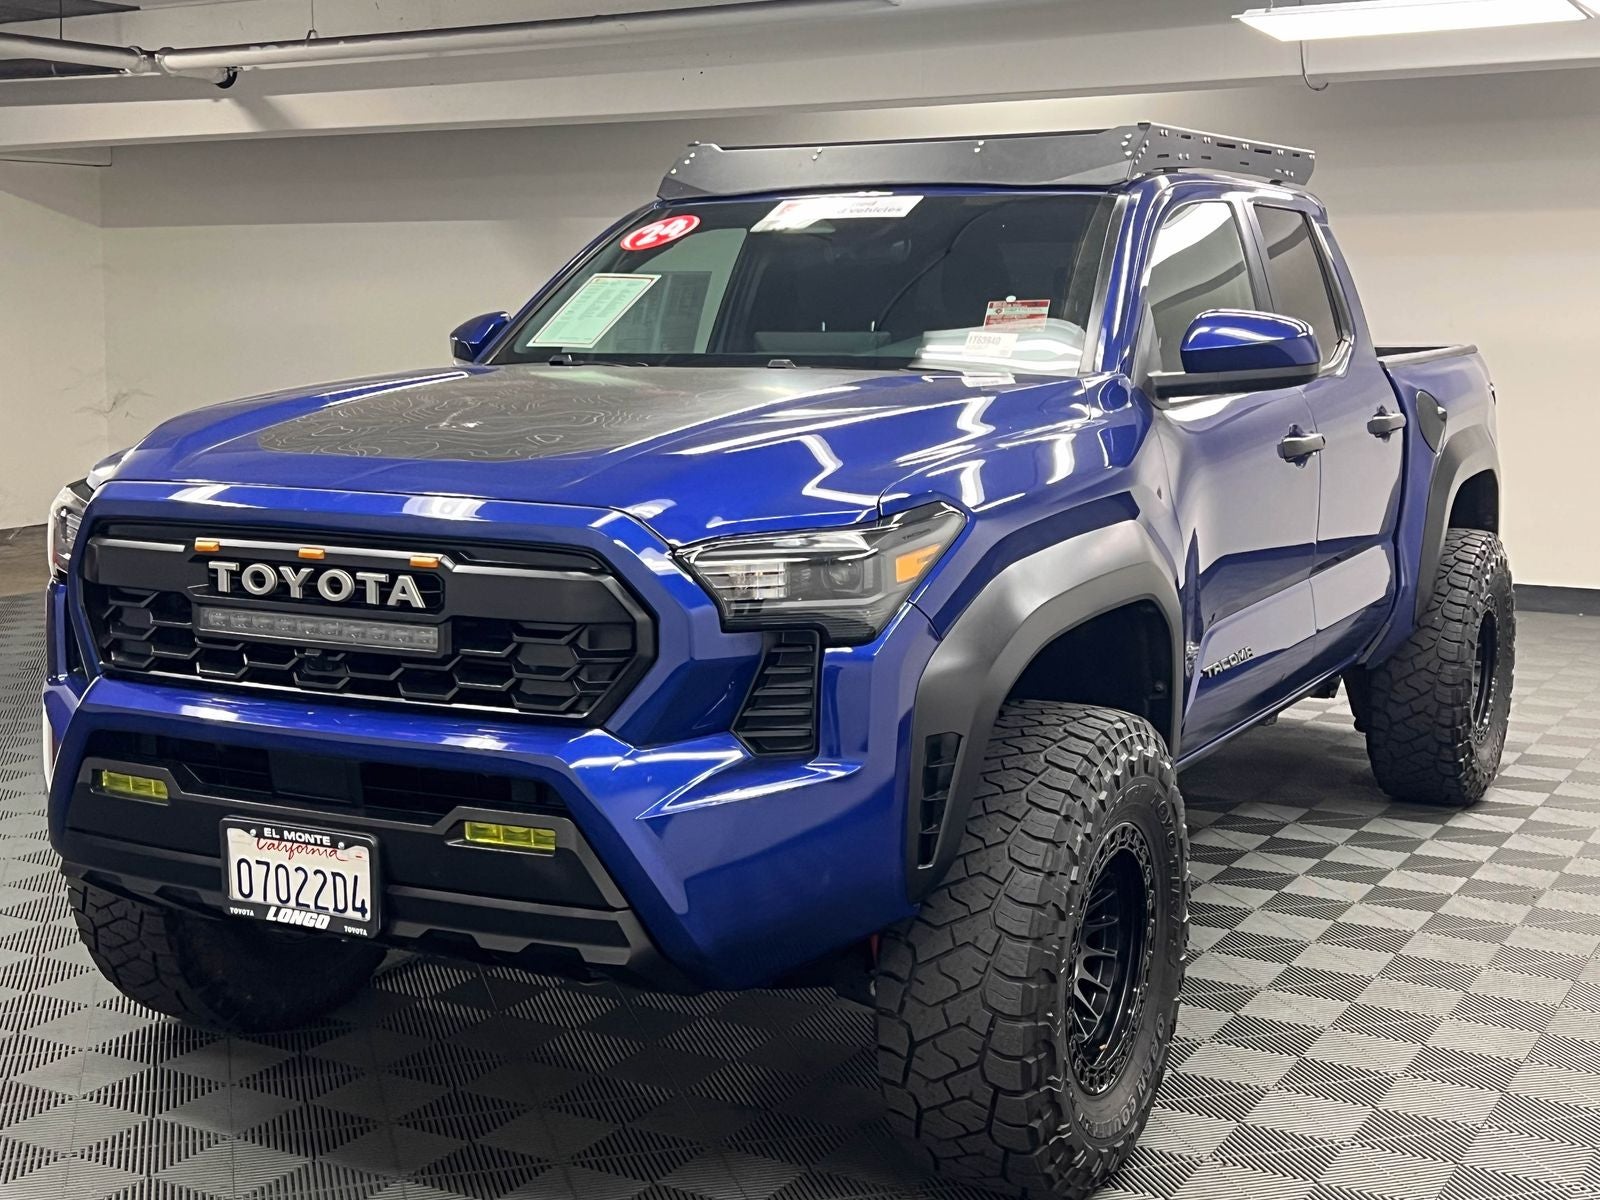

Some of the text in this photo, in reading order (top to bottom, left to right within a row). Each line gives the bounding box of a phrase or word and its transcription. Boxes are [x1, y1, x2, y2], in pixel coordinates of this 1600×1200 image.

[635, 219, 688, 246] 24
[208, 561, 426, 609] TOYOTA
[1201, 646, 1254, 678] TACOMA
[256, 837, 349, 861] California
[264, 828, 331, 846] EL MONTE
[236, 858, 368, 918] 07022D4
[230, 907, 255, 917] TOYOTA
[265, 906, 331, 930] LONGO
[344, 925, 368, 937] TOYOTA
